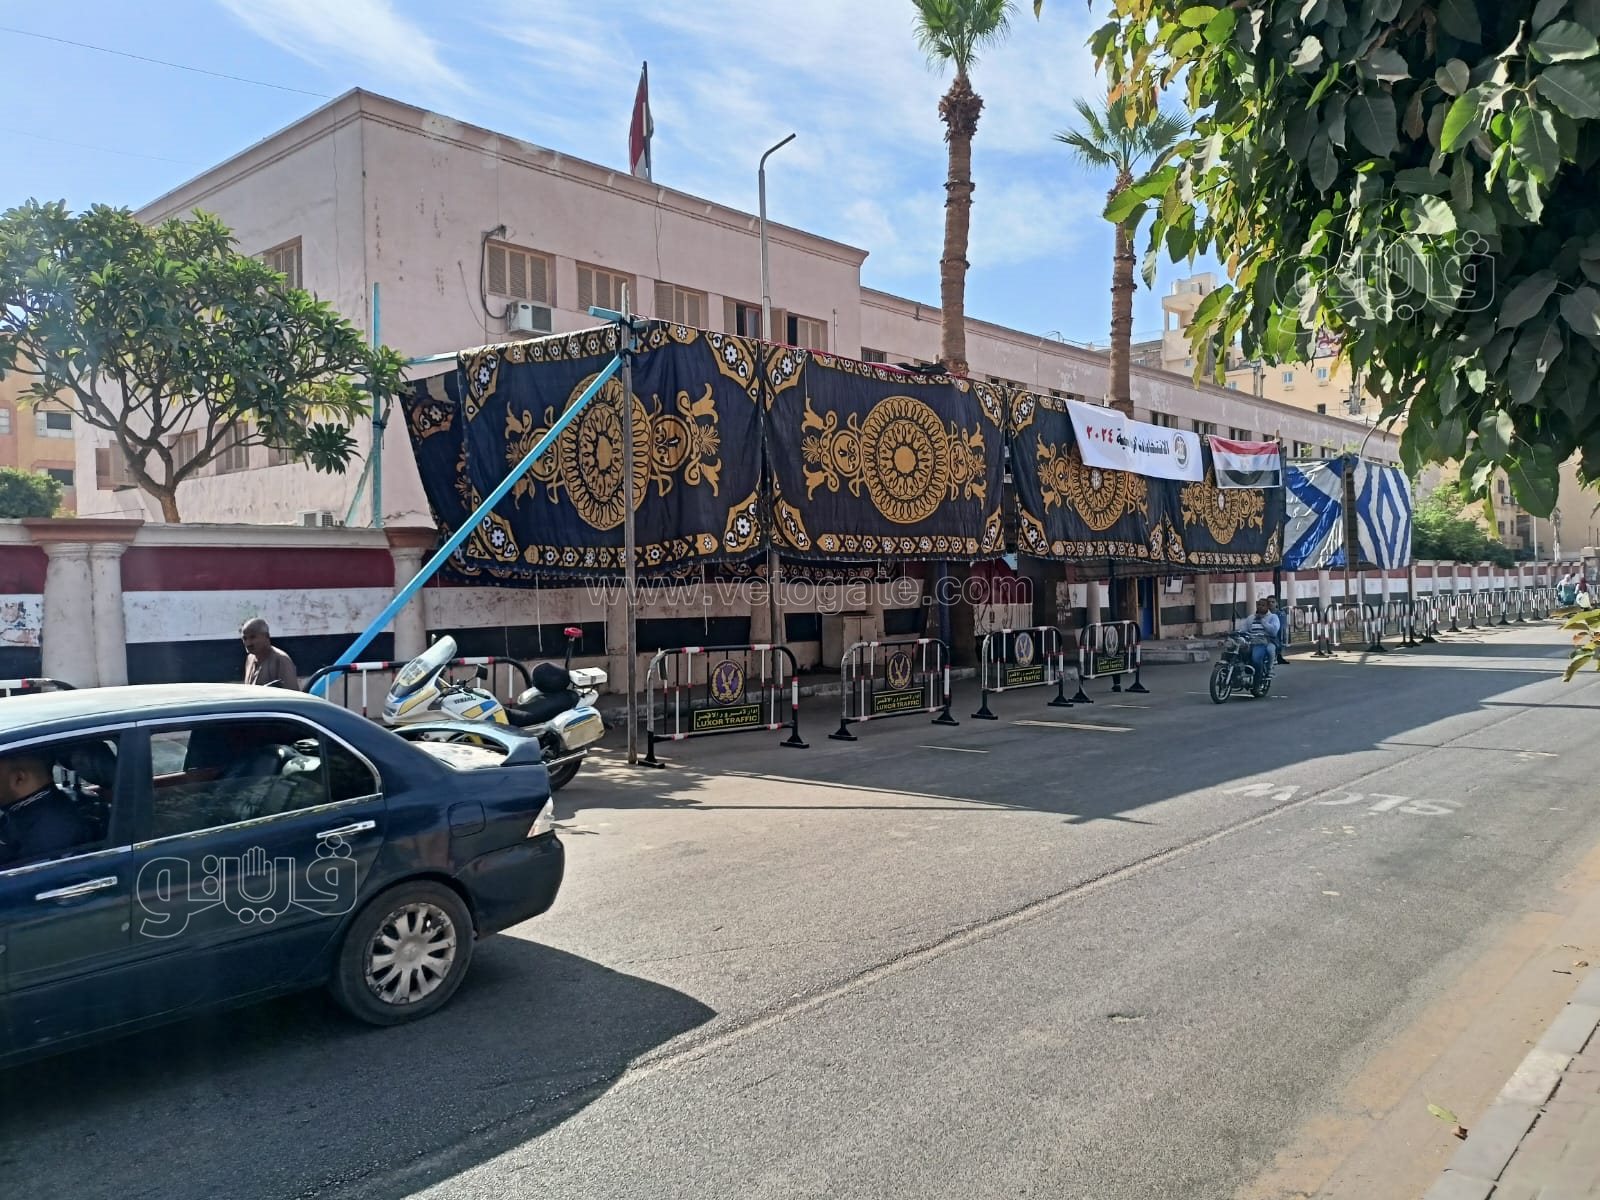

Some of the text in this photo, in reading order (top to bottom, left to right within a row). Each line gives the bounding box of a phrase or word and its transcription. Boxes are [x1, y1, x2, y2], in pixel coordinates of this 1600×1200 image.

[1085, 424, 1114, 445] ٢٠٢٤
[897, 700, 920, 708] TRAFFIC
[696, 716, 758, 728] LUXOR TRAFFIC
